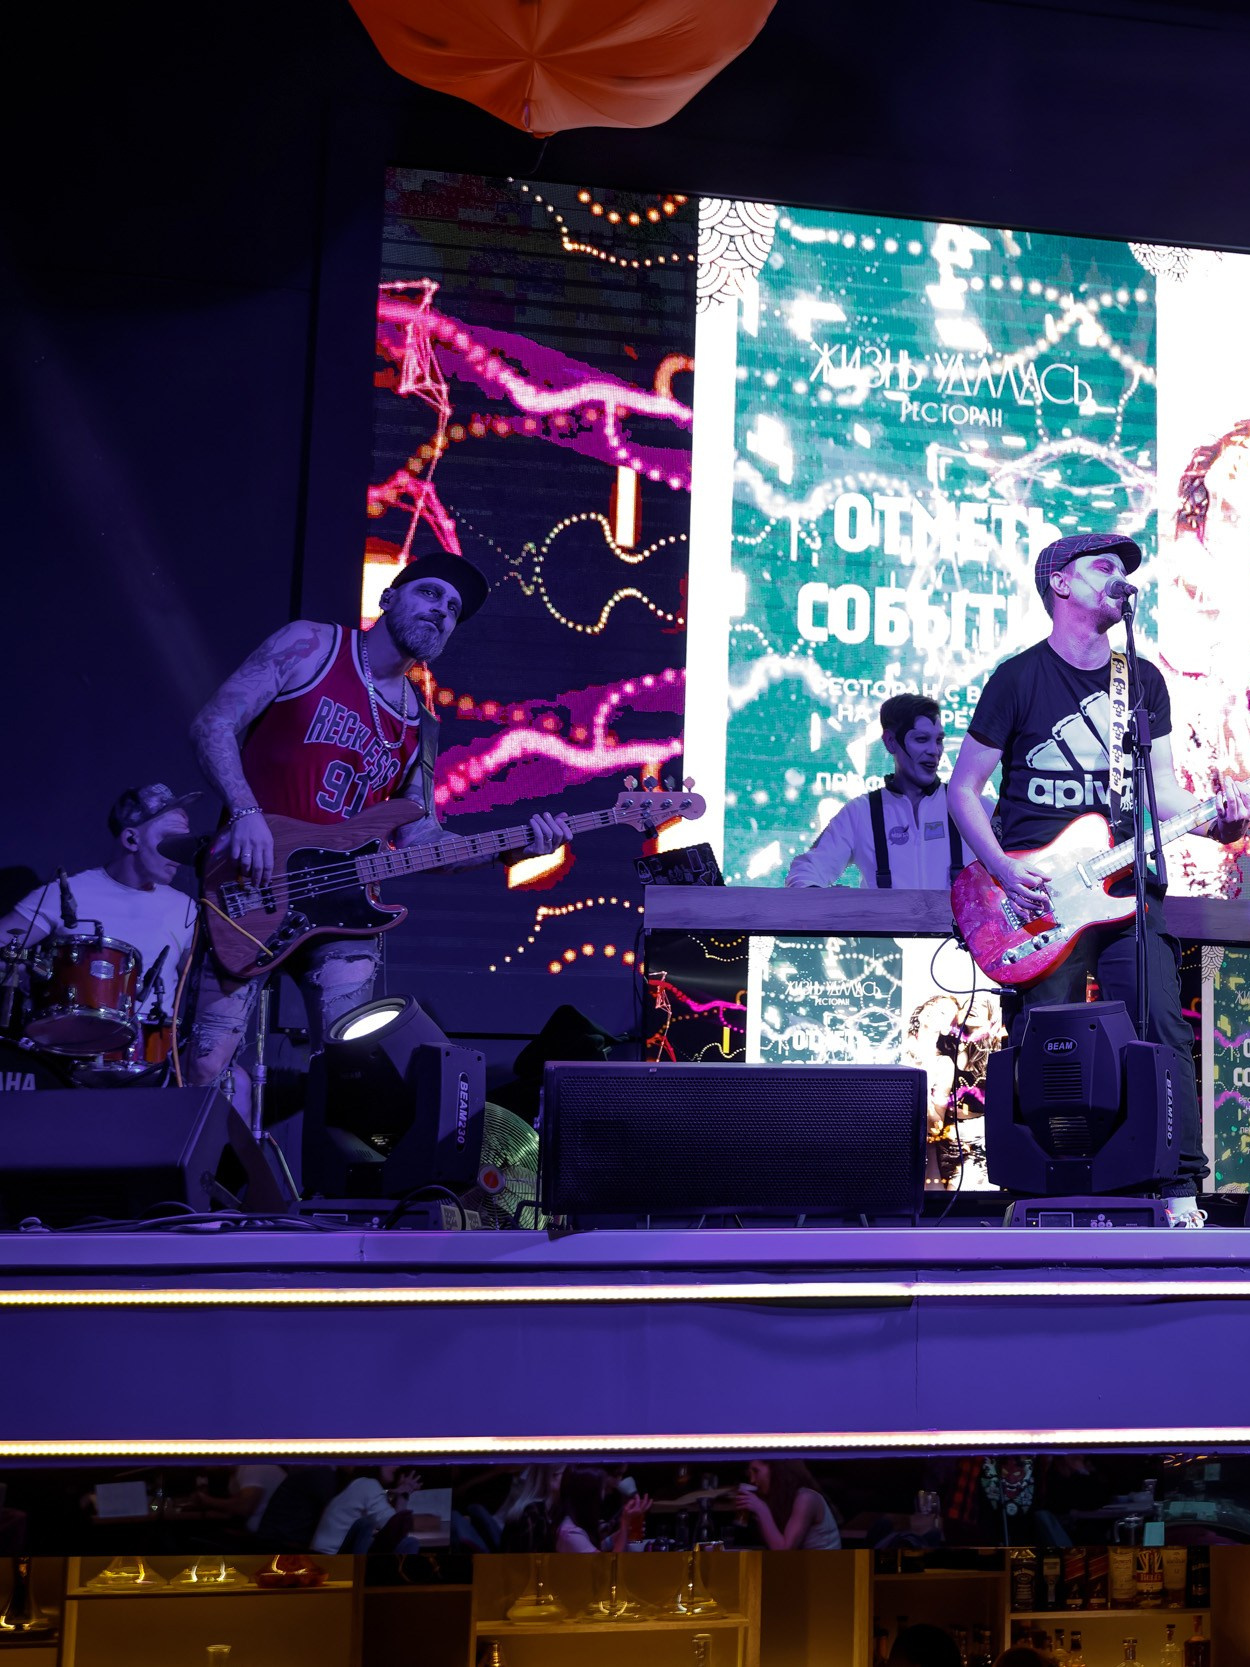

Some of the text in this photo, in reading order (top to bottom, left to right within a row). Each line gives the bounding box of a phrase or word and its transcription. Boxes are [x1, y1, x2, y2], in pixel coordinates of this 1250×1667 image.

[809, 342, 1094, 406] ЖИЗНЬ УДАЛАСЬ
[901, 401, 1002, 428] РЕСТОРАН
[304, 695, 401, 793] RECKESS
[315, 759, 370, 819] 91
[1047, 1041, 1074, 1051] BEAM
[456, 1080, 468, 1144] BEAM230
